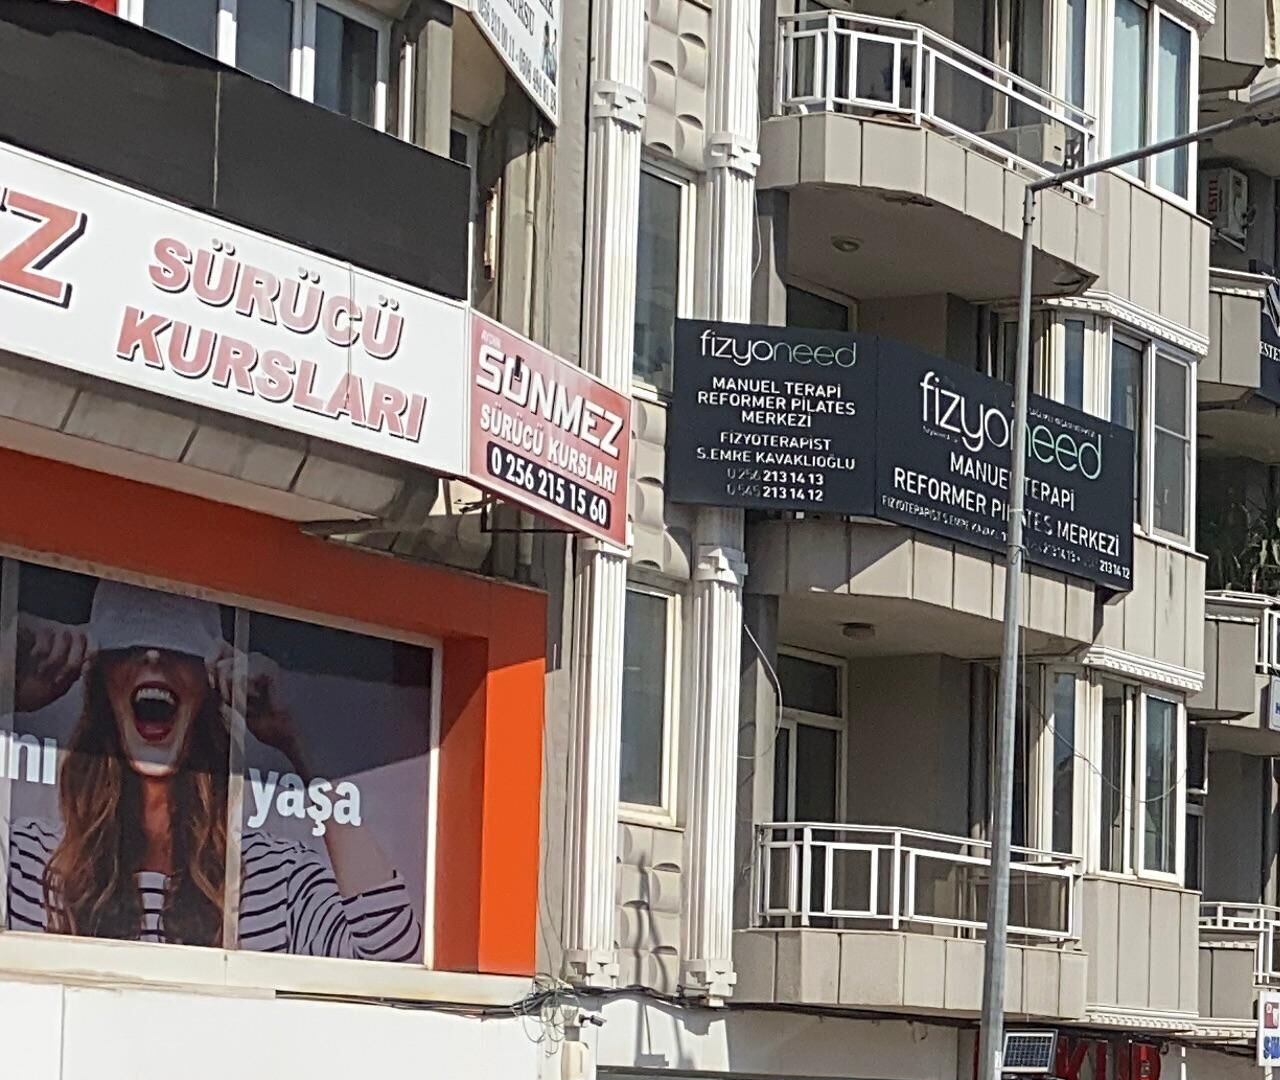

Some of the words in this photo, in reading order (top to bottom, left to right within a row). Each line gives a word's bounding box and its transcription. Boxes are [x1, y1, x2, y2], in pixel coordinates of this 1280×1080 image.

[0, 186, 87, 308] Z
[149, 238, 406, 358] SÜRÜCÜ
[700, 329, 857, 368] fizyoneed
[116, 306, 428, 442] KURSLARI
[713, 376, 780, 394] MANUEL
[784, 381, 841, 398] TERAPİ
[698, 391, 786, 410] REFORMER
[791, 396, 856, 415] PİLATES
[742, 411, 811, 428] MERKEZİ
[480, 403, 545, 456] SÜRÜCÜ
[548, 437, 617, 494] KURSLARI
[696, 447, 751, 462] S.EMRE
[755, 451, 856, 470] KAVAKLIOĞLU
[720, 430, 832, 451] FİZYOTERAPİST
[491, 447, 502, 477] 0
[506, 454, 535, 493] 256
[538, 468, 565, 504] 215
[569, 484, 586, 515] 15
[589, 495, 607, 525] 60
[763, 470, 787, 482] 213
[789, 472, 805, 484] 14
[808, 473, 824, 485] 13
[763, 486, 787, 499] 213
[789, 488, 805, 500] 14
[807, 489, 823, 501] 12
[894, 467, 987, 515] REFORMER
[1057, 520, 1119, 557] MERKEZİ
[247, 767, 362, 837] yaşa
